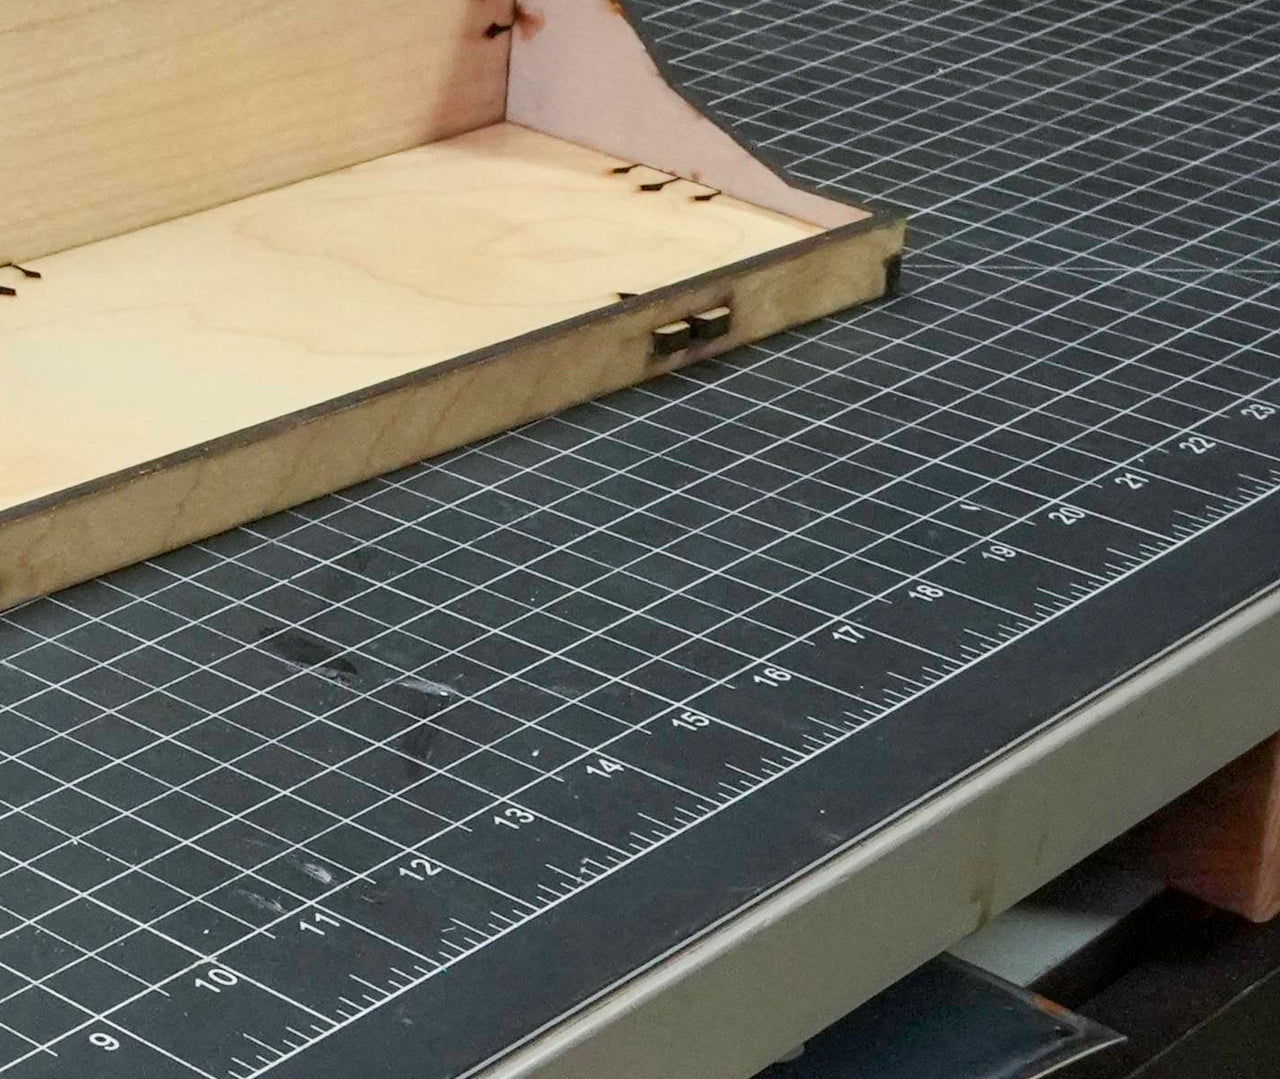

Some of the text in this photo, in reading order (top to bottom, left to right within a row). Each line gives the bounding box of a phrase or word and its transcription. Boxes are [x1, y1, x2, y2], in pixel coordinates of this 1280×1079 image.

[1179, 437, 1216, 454] 22
[1049, 506, 1086, 525] 20
[909, 584, 943, 602] 18
[753, 668, 792, 687] 16
[586, 758, 624, 779] 14
[399, 858, 442, 882] 12
[195, 969, 238, 993] 10
